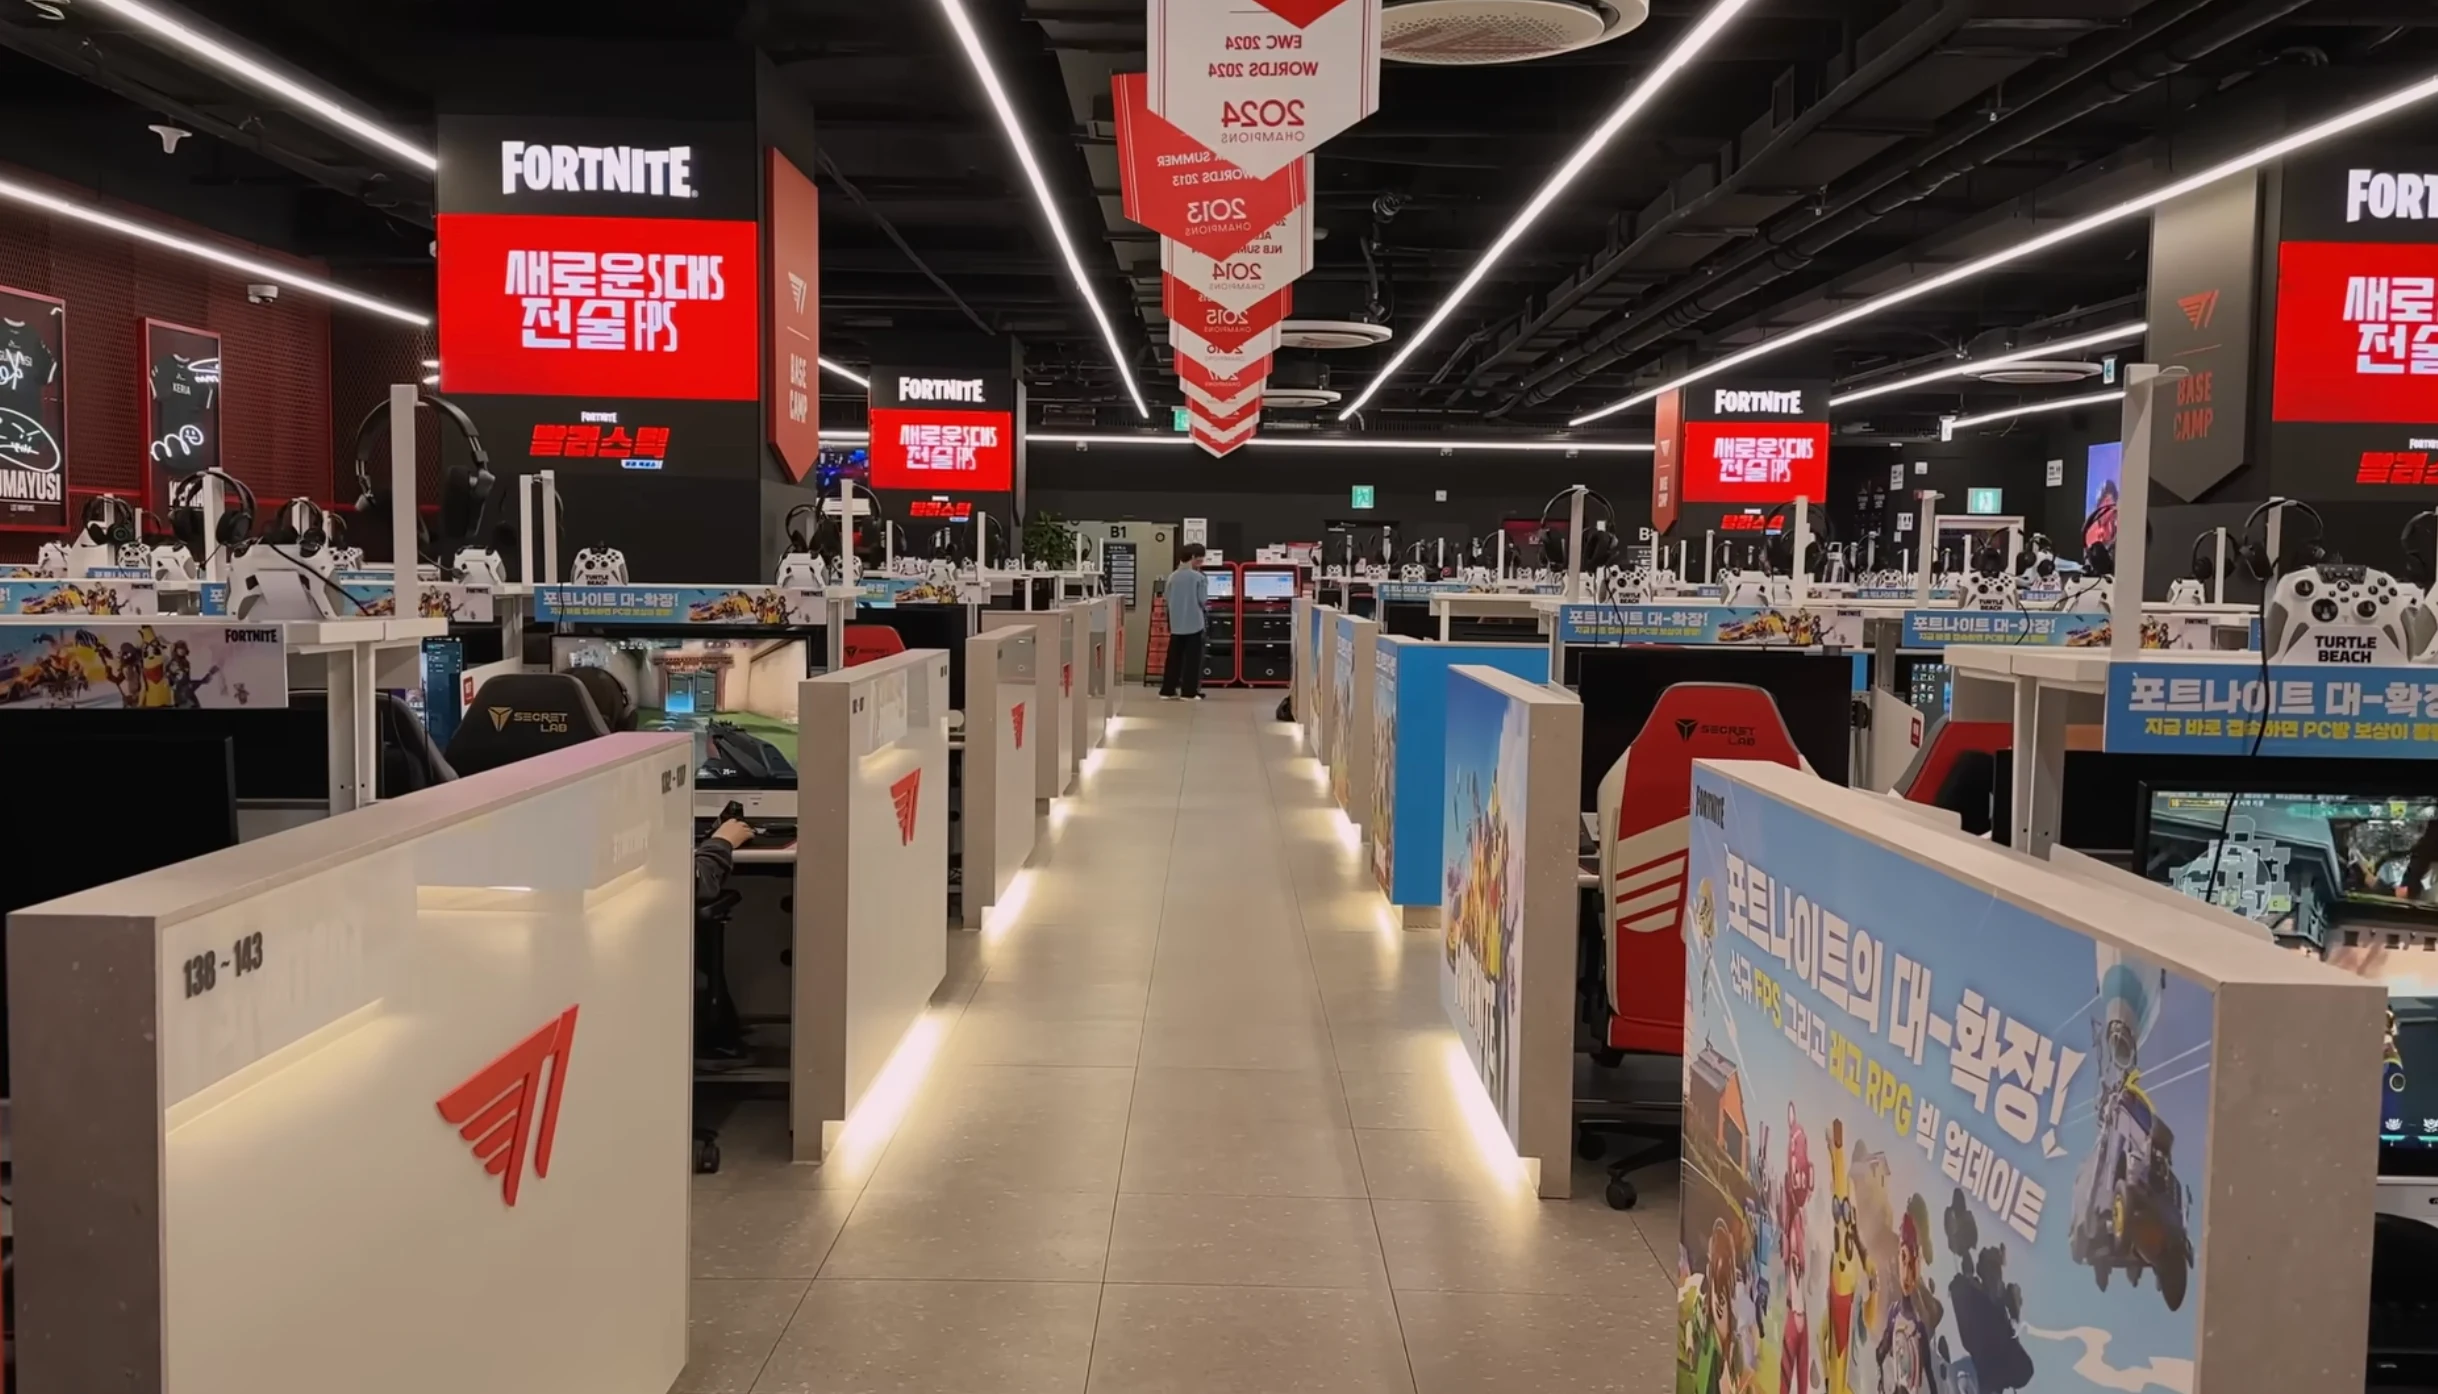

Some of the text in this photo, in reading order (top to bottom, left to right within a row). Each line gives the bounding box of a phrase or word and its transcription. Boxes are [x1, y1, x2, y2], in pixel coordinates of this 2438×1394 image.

[502, 141, 691, 198] FORTNITE
[522, 298, 679, 352] 전술 FPS
[172, 382, 191, 396] KERIA
[899, 377, 985, 402] FORTNITE
[2177, 372, 2213, 406] BASE
[1715, 389, 1802, 414] FORTNITE
[2173, 409, 2214, 441] CAMP
[1110, 525, 1127, 539] B1
[543, 590, 617, 606] 포트나이트
[1568, 608, 1643, 625] 포트나이트
[1912, 614, 1990, 632] 포트나이트
[225, 628, 277, 643] FORTNITE
[2314, 635, 2377, 649] TURTLE
[2317, 650, 2372, 663] BEACH
[2128, 672, 2315, 714] 포트나이트
[514, 712, 568, 723] SECRET
[540, 723, 567, 733] LAB
[1701, 724, 1755, 736] SECRET
[2145, 717, 2181, 736] 지금
[2186, 718, 2222, 737] 바로
[2226, 719, 2299, 739] 접속하면
[2303, 721, 2350, 740] PC방
[2354, 722, 2408, 741] 보상이
[1728, 736, 1755, 746] LAB
[1696, 785, 1725, 829] FORTNITE
[1725, 843, 1883, 1033] 포트나이트의
[184, 950, 216, 999] 138
[234, 931, 263, 977] 143
[1730, 949, 2046, 1243] 신규 FPS 그리고 레고 RPG 빅 업데이트
